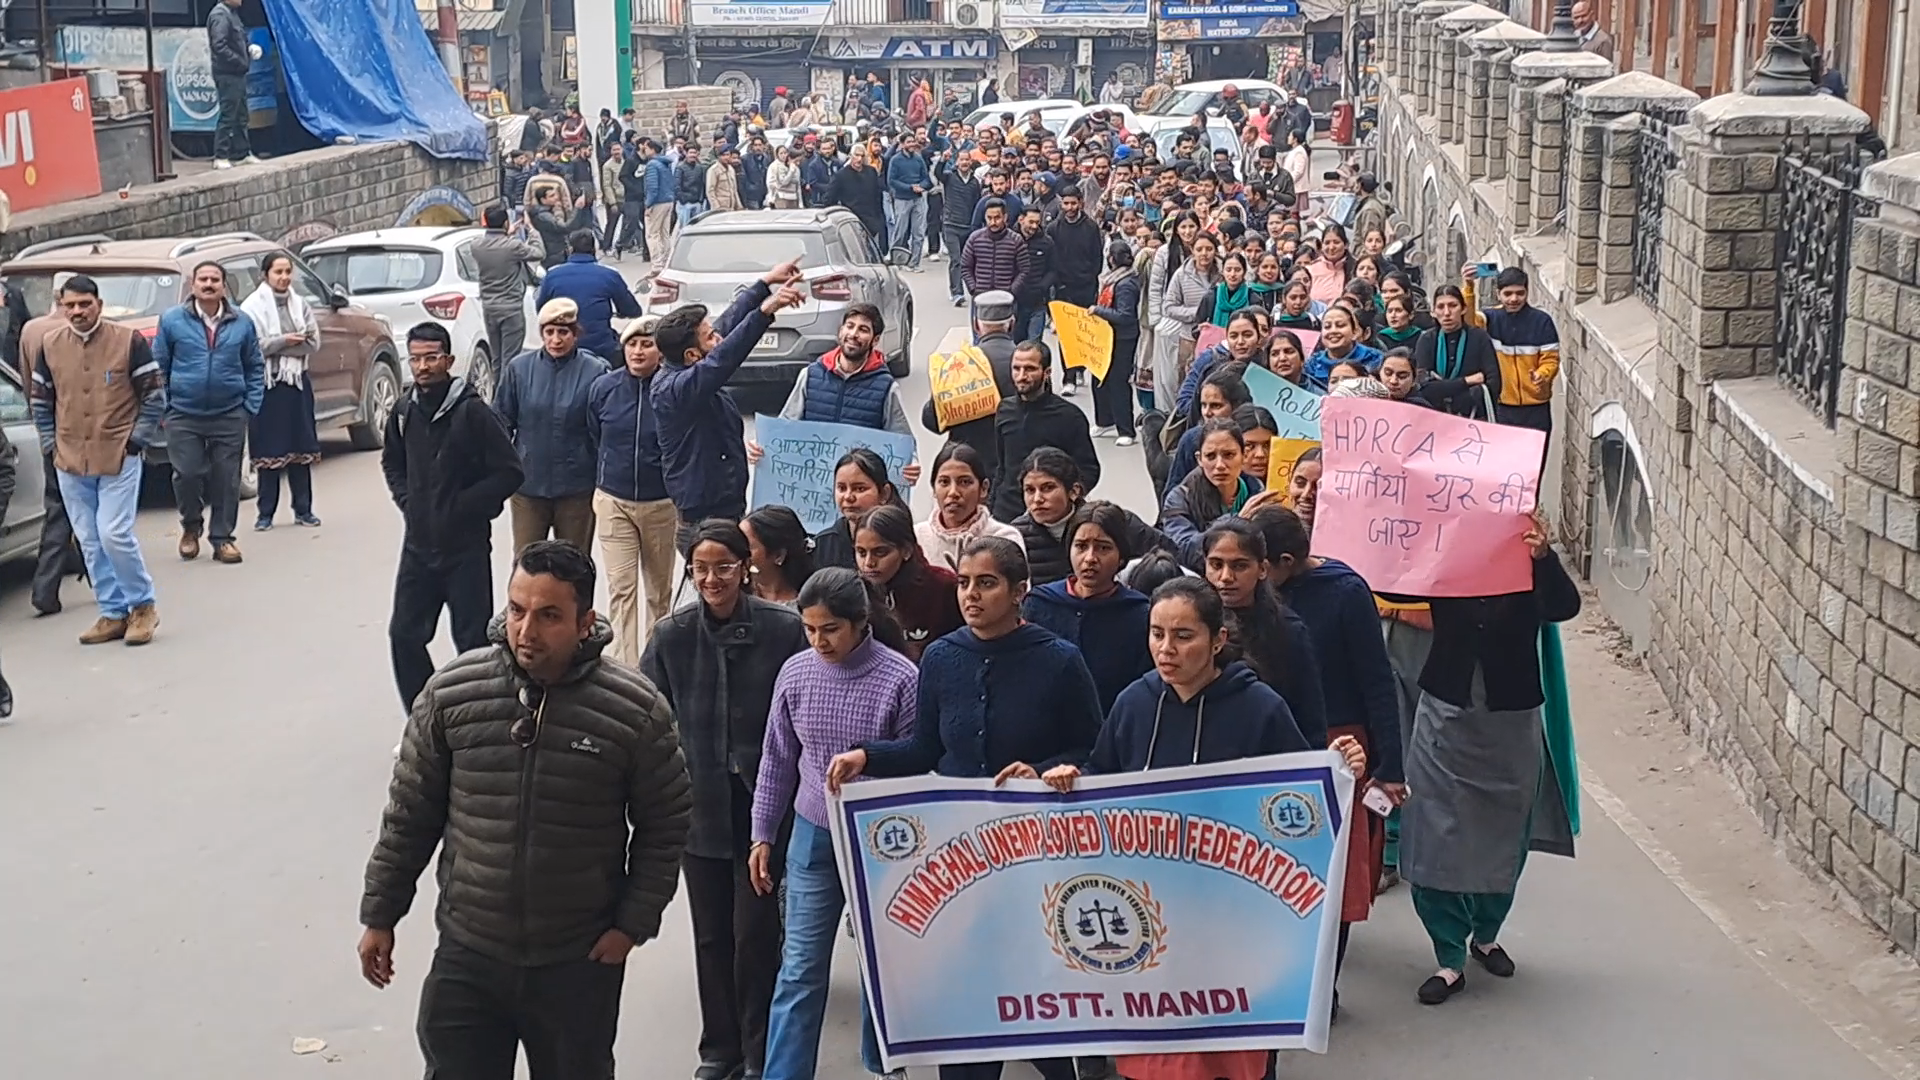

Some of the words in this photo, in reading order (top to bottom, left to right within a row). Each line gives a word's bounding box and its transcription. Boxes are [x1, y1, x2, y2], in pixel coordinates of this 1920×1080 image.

[749, 6, 777, 15] Office
[893, 40, 988, 57] ATM
[943, 394, 996, 421] Shopping
[1334, 415, 1435, 462] HPRCA
[887, 835, 990, 935] HIMACHAL
[977, 811, 1102, 866] UNEMPLOYED
[1104, 812, 1181, 856] YOUTH
[1184, 816, 1327, 915] FEDERATION
[997, 992, 1114, 1023] DISTT.
[1122, 987, 1250, 1019] MANDI
